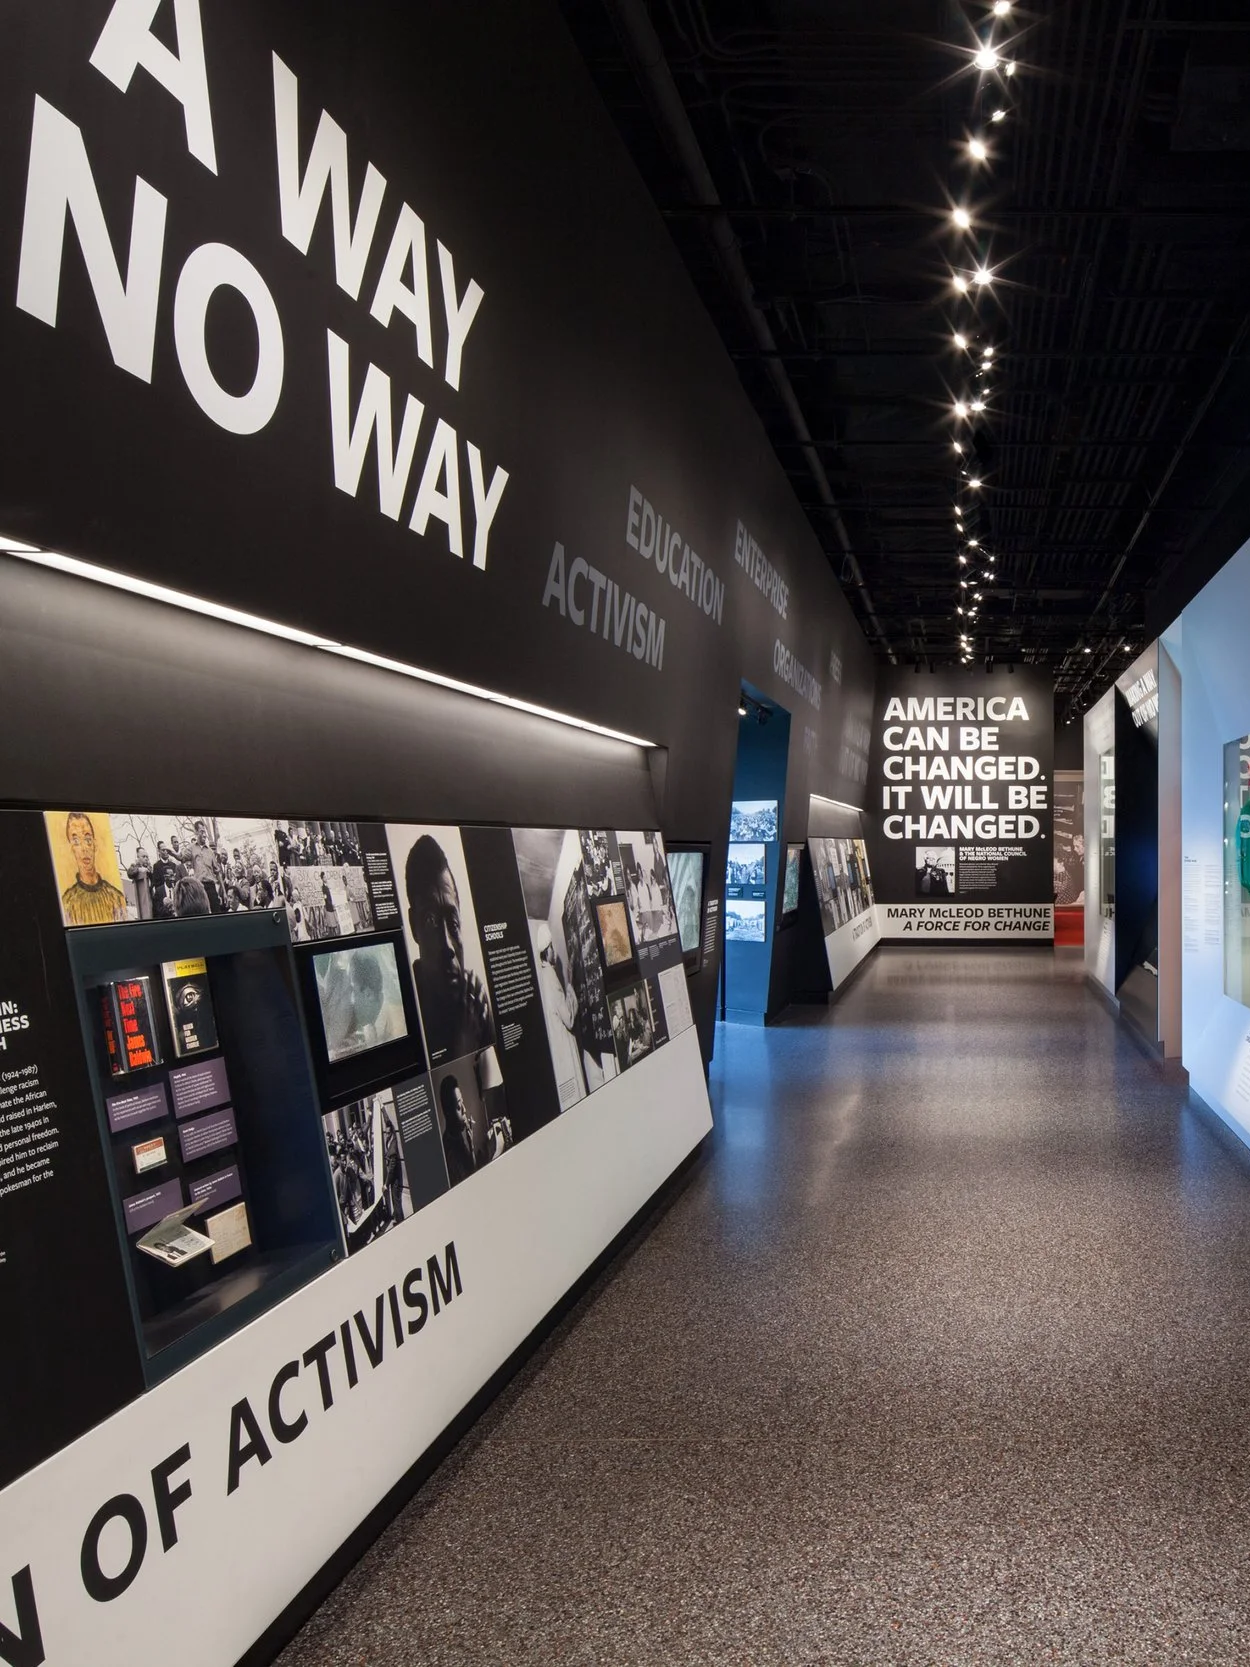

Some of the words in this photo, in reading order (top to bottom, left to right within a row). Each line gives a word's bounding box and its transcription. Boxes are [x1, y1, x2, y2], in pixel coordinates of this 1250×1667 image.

[89, 0, 217, 176] A
[272, 50, 484, 392] WAY
[16, 93, 284, 435] NO
[327, 328, 509, 571] WAY
[626, 484, 725, 626] EDUCATION
[735, 519, 789, 620] ENTERPRISE
[542, 541, 667, 672] ACTIVISM
[773, 639, 822, 711] ORGANIZATIONS
[883, 697, 1029, 721] AMERICA
[883, 727, 949, 751] CAN
[960, 727, 999, 751] BE
[883, 756, 1046, 780] CHANGED.
[883, 786, 912, 810] IT
[921, 786, 999, 810] WILL
[1009, 786, 1048, 810] BE
[883, 815, 1046, 839] CHANGED.
[887, 908, 925, 918] MARY
[929, 908, 983, 918] McLEOD
[988, 908, 1051, 918] BETHUNE
[485, 931, 504, 941] SCHOOLS
[903, 921, 912, 931] A
[917, 921, 960, 931] FORCE
[964, 921, 991, 931] FOR
[994, 921, 1050, 931] CHANGE
[18, 1079, 39, 1090] racism
[13, 1096, 24, 1105] the
[25, 1090, 47, 1102] African
[6, 1109, 25, 1121] raised
[33, 1101, 57, 1113] Harlem,
[11, 1125, 23, 1134] late
[24, 1119, 42, 1130] 1940s
[42, 1116, 50, 1124] in
[4, 1134, 31, 1153] personal
[14, 1151, 28, 1160] him
[28, 1148, 36, 1157] to
[36, 1141, 59, 1154] reclaim
[3, 1167, 16, 1180] and
[16, 1166, 25, 1175] he
[25, 1157, 50, 1171] became
[32, 1174, 42, 1183] for
[43, 1169, 54, 1179] the
[81, 1442, 192, 1603] OF
[227, 1241, 463, 1497] ACTIVISM
